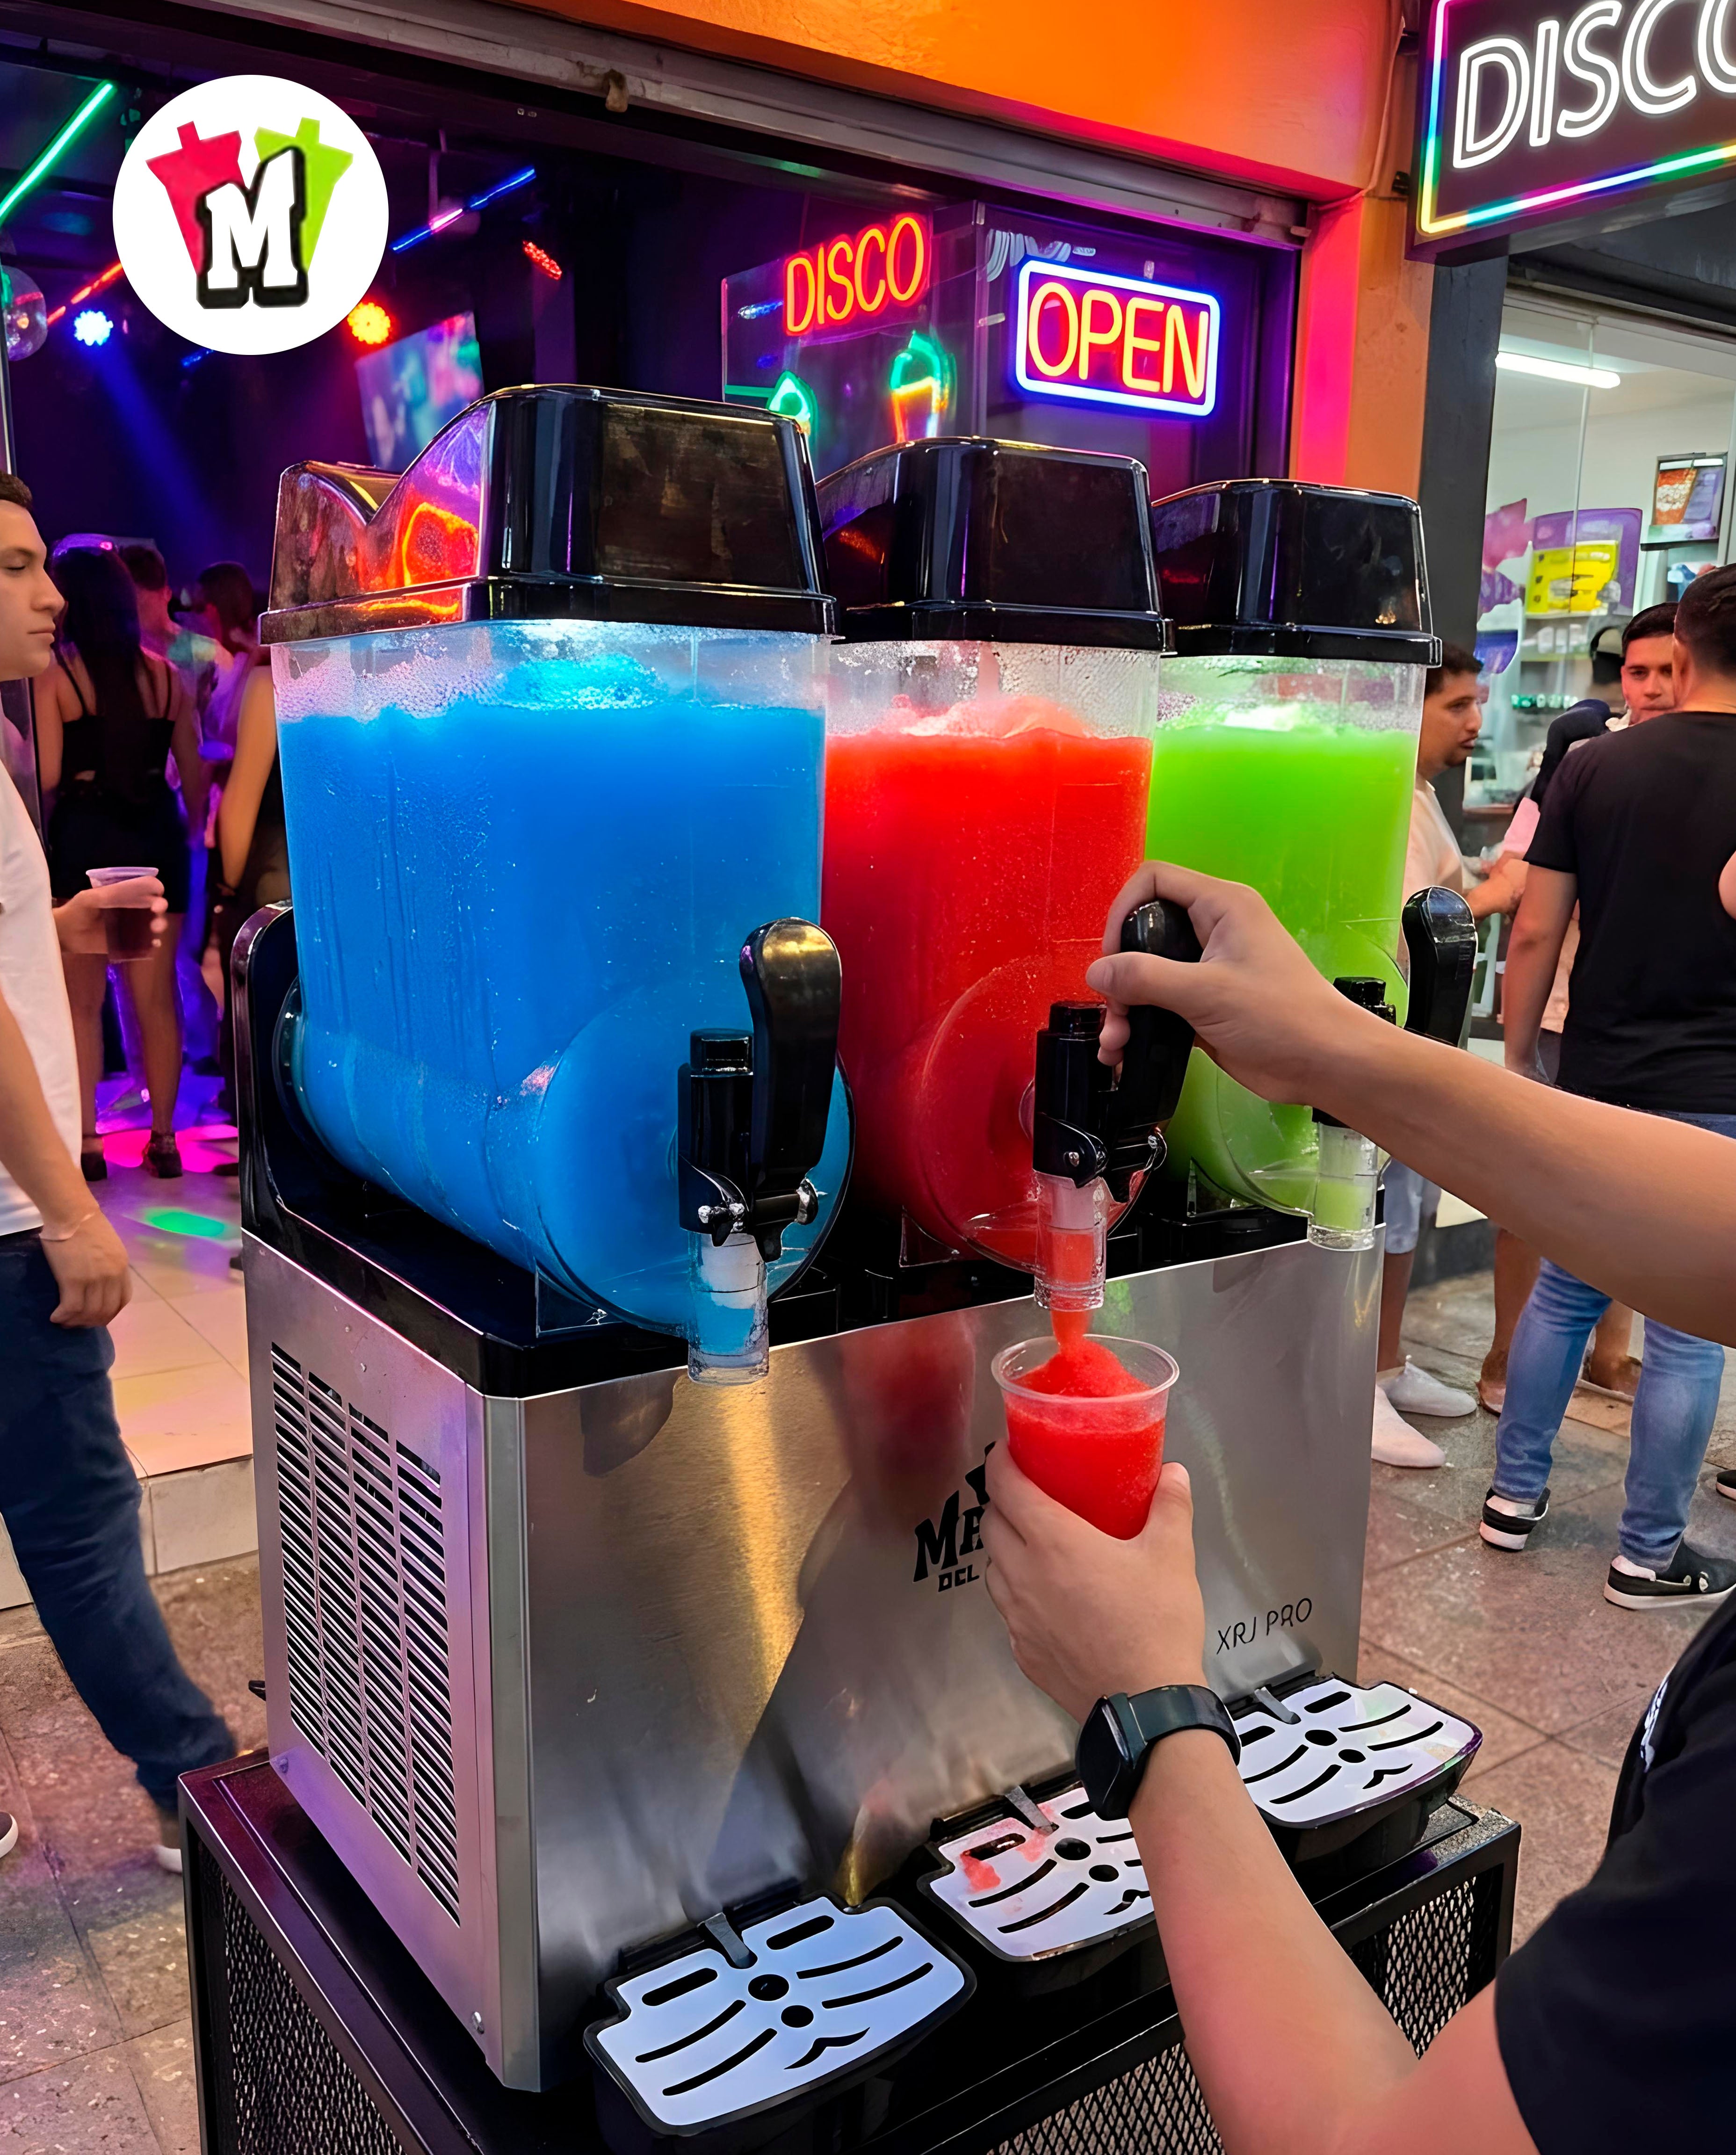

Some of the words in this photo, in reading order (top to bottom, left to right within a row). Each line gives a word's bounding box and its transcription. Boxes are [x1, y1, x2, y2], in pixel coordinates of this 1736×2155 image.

[784, 215, 926, 334] DISCO
[1028, 282, 1209, 399] OPEN
[1216, 1616, 1256, 1655] XRJ
[1266, 1598, 1312, 1636] PRO
